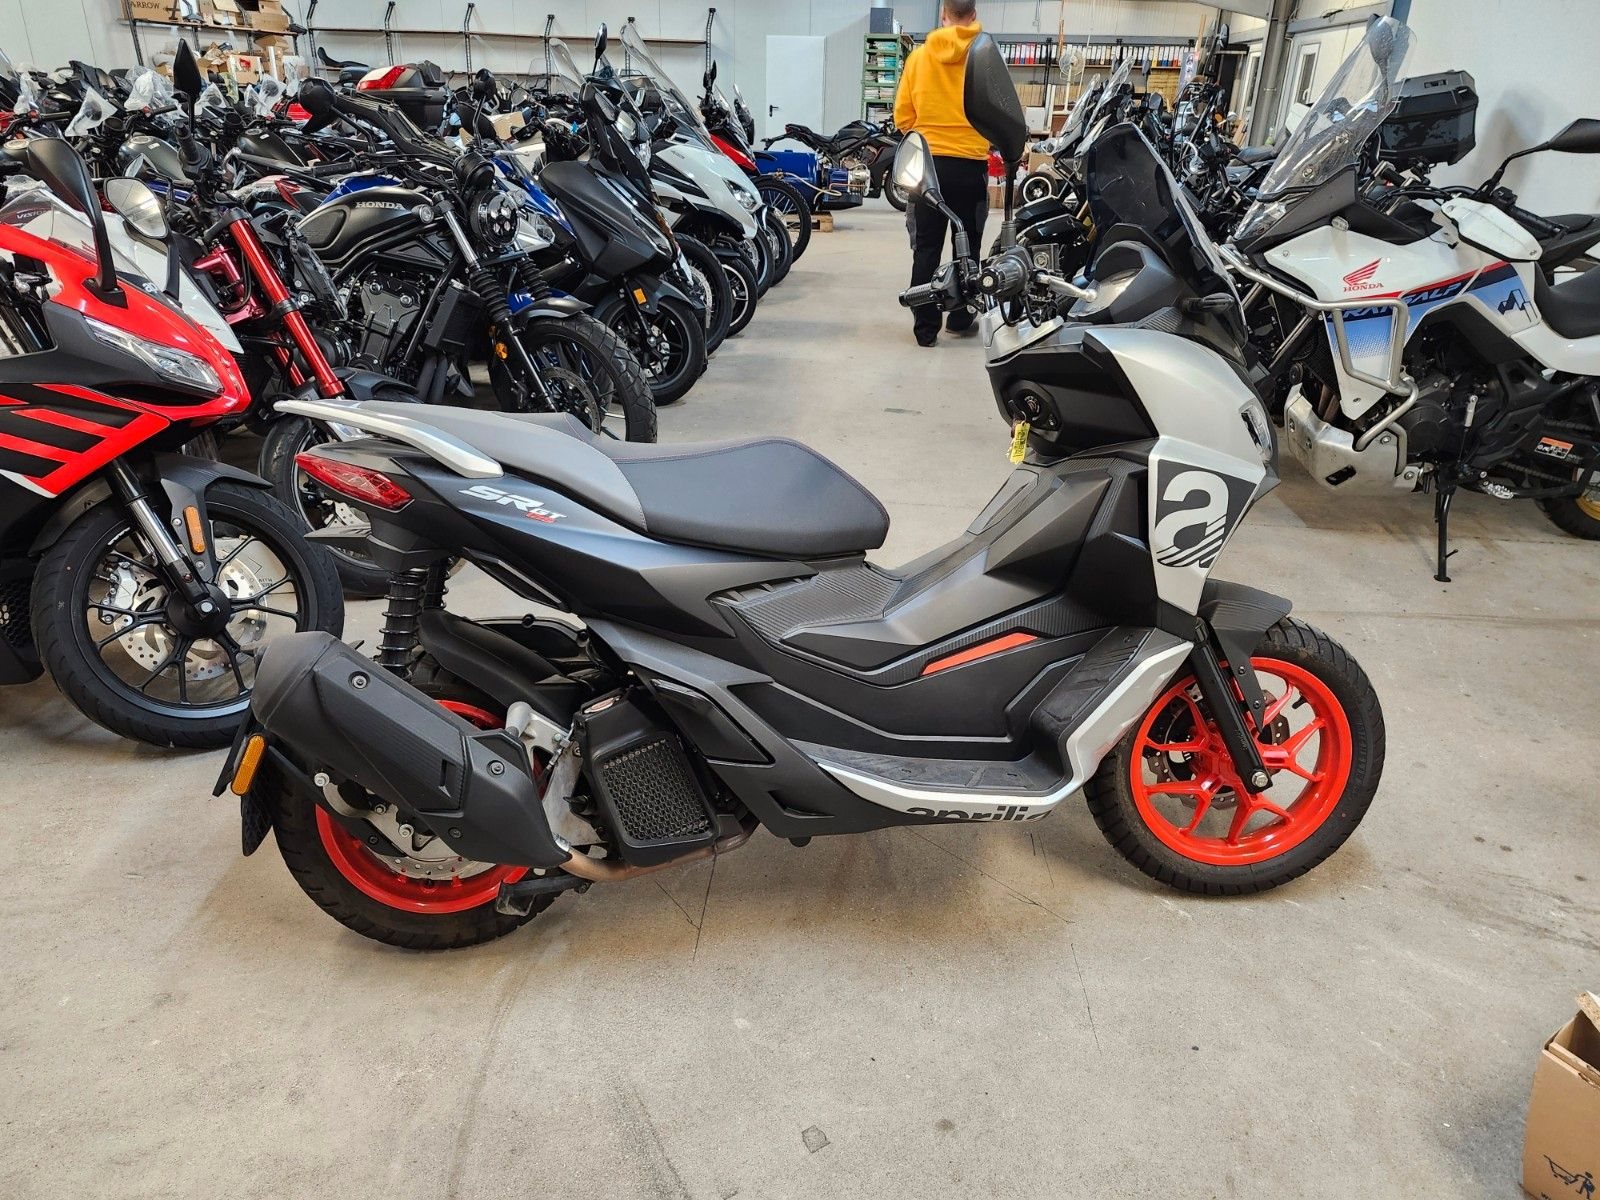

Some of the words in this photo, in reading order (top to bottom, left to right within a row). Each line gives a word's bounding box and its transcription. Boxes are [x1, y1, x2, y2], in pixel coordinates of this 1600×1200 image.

[131, 0, 160, 9] ARROW
[355, 201, 405, 210] HONDA
[1343, 282, 1384, 292] HONDA
[458, 485, 544, 511] SR
